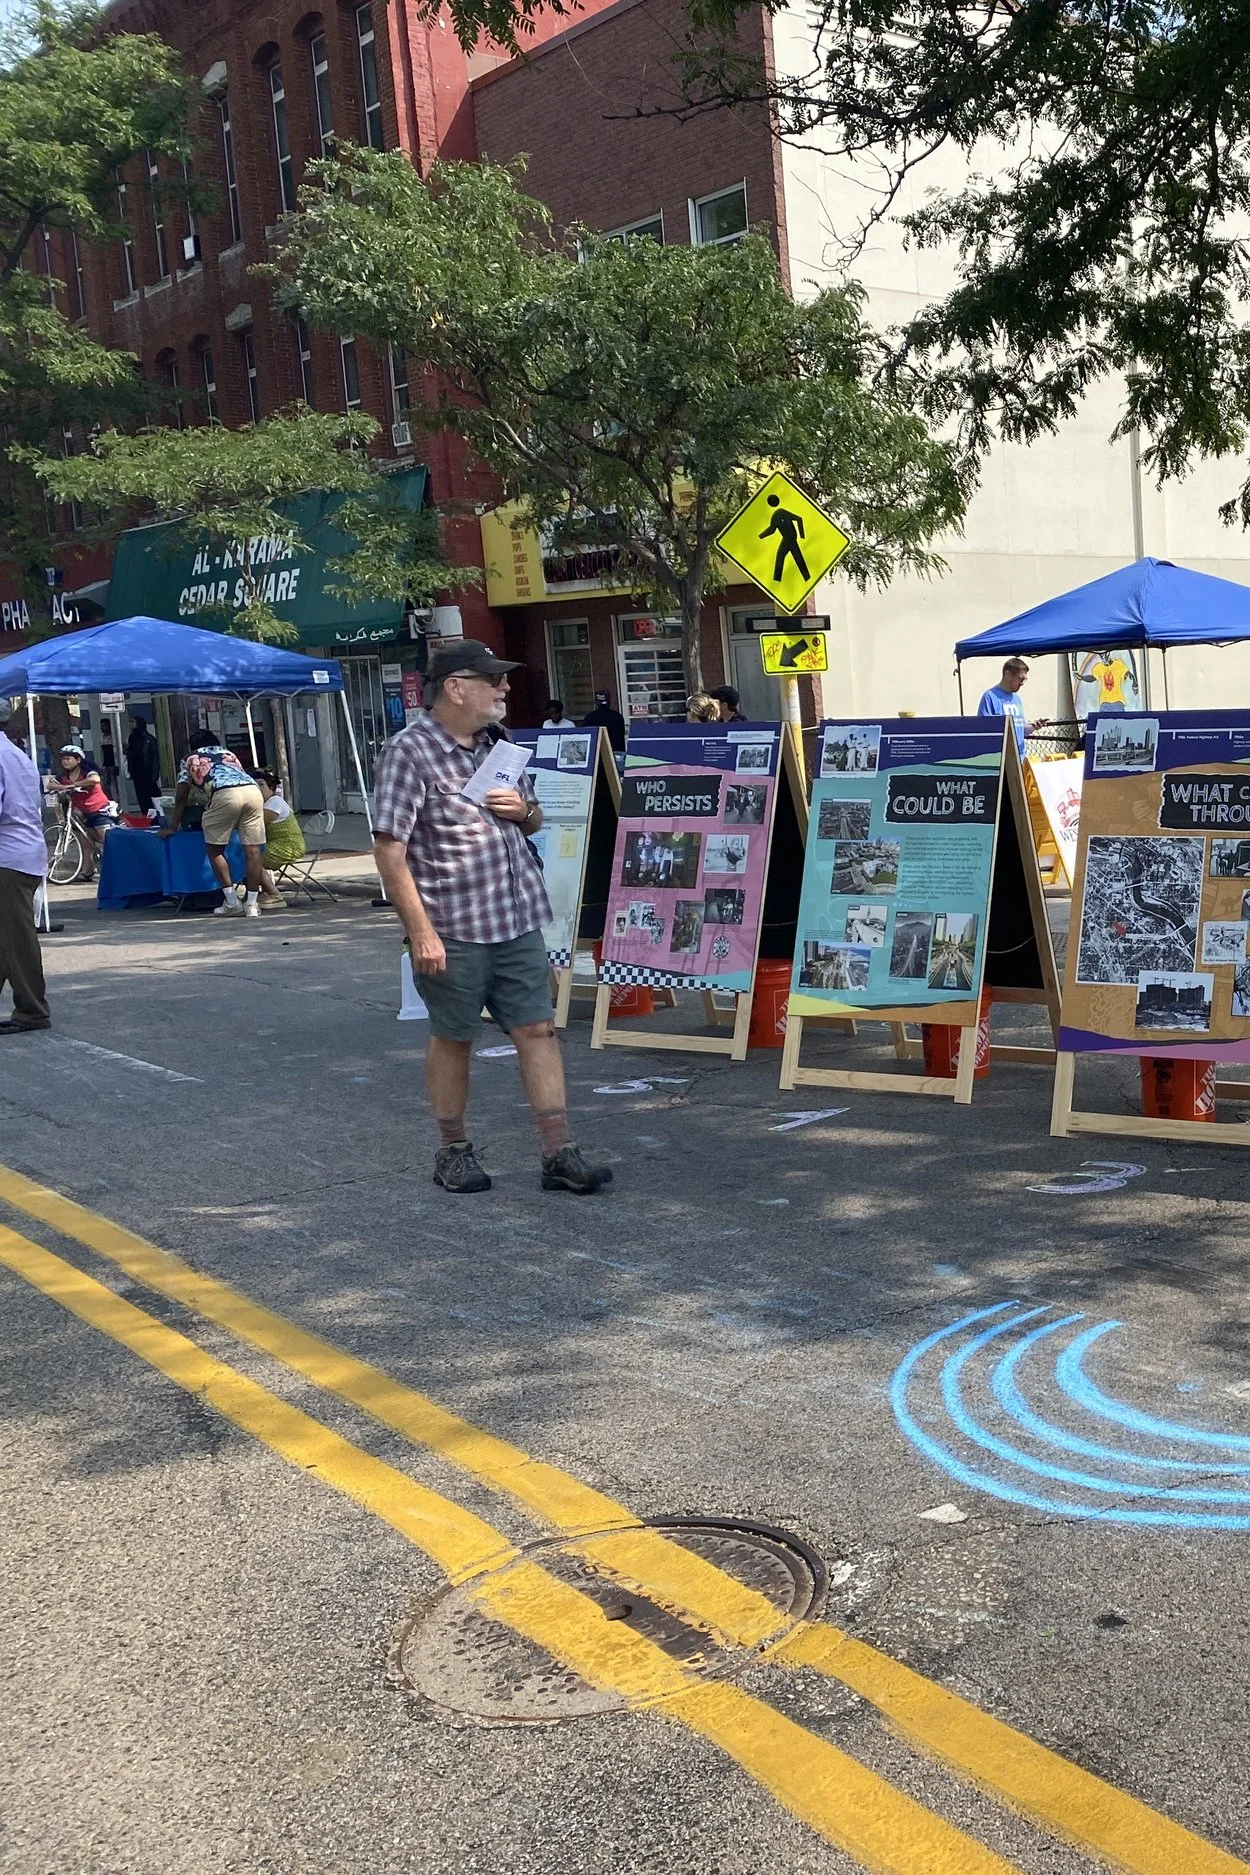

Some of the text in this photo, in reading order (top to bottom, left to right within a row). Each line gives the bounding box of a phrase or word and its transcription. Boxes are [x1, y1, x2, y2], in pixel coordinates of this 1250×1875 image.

[179, 580, 228, 616] CEDAR
[636, 780, 666, 794] WHO
[936, 781, 976, 795] WHAT
[1171, 784, 1234, 803] WHAT
[645, 795, 712, 812] PERSISTS
[892, 796, 985, 815] COULD BE
[1025, 1160, 1147, 1194] 3
